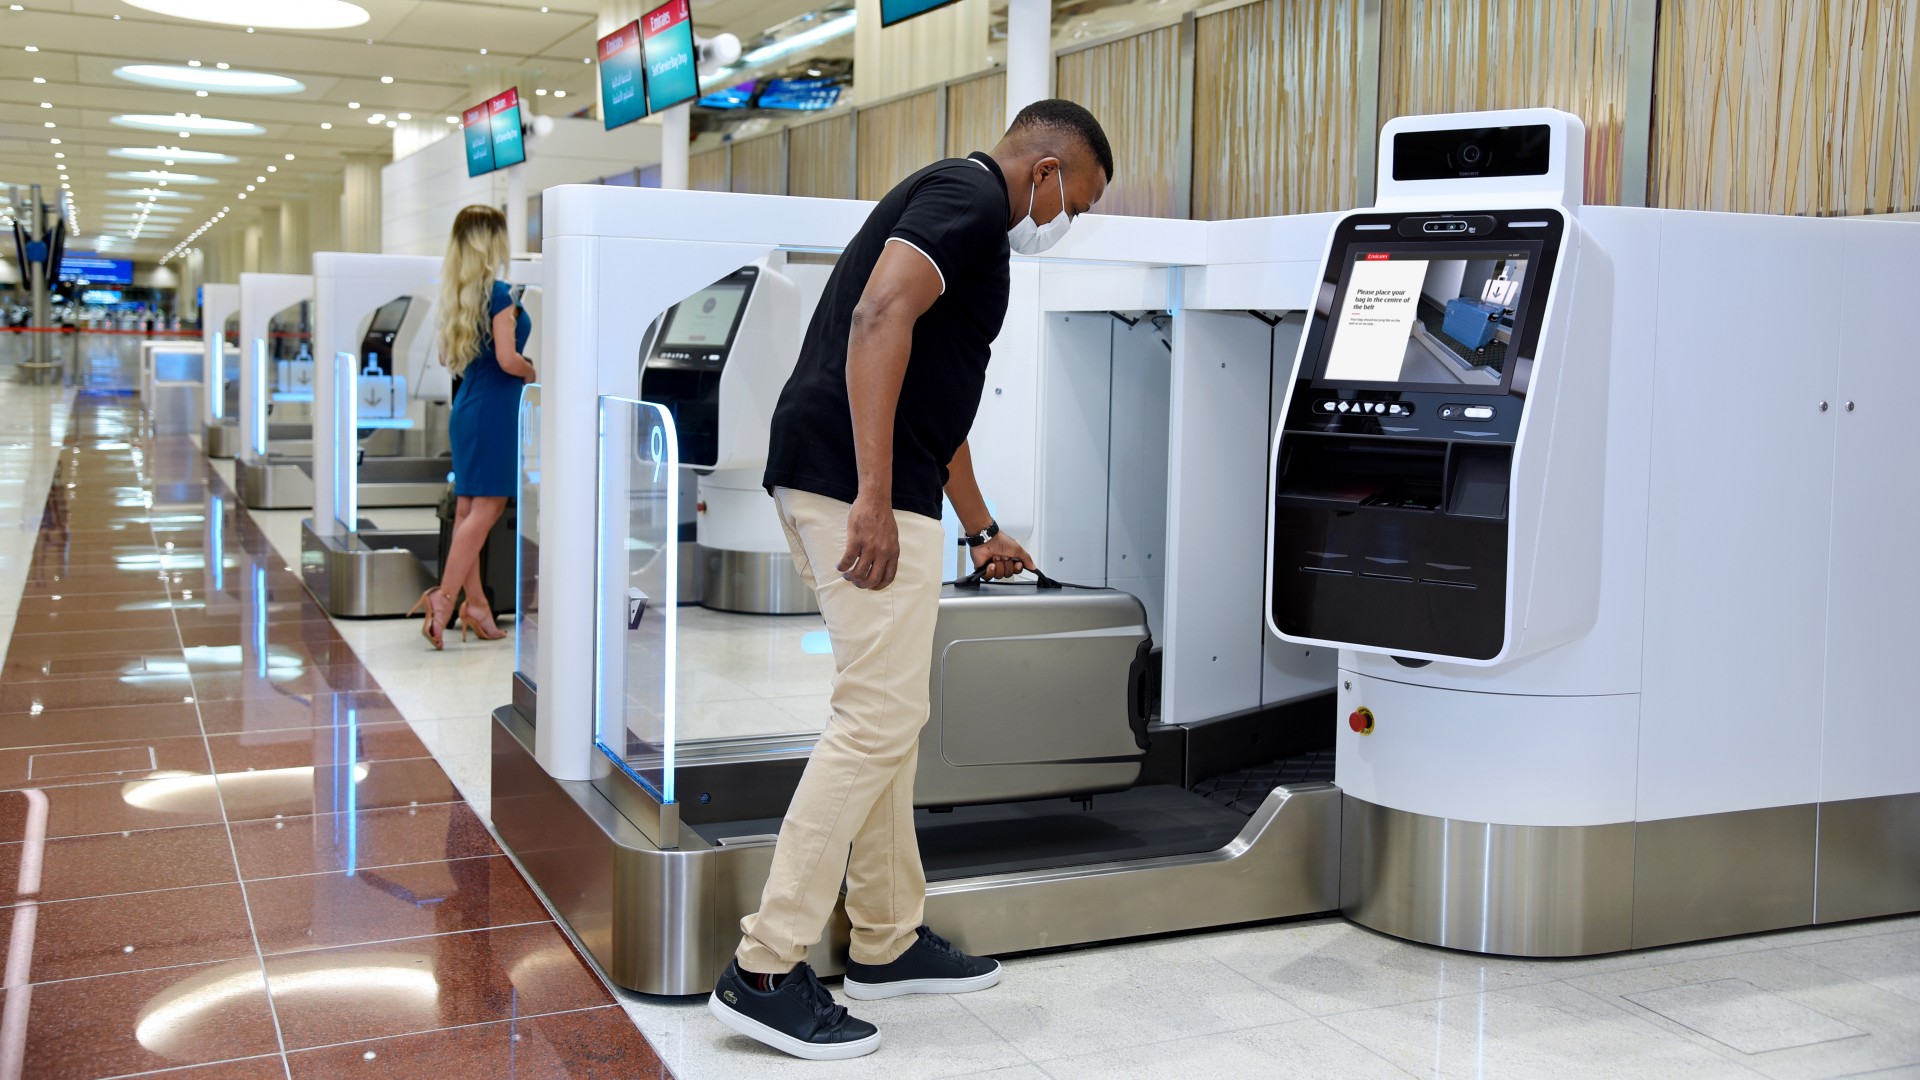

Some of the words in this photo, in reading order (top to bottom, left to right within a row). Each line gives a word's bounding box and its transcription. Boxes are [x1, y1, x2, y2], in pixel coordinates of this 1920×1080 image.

[650, 11, 671, 32] Emirates
[651, 64, 659, 77] Self
[658, 59, 672, 75] Service
[677, 53, 688, 66] Drop
[1354, 296, 1366, 304] bag
[651, 425, 663, 484] 9
